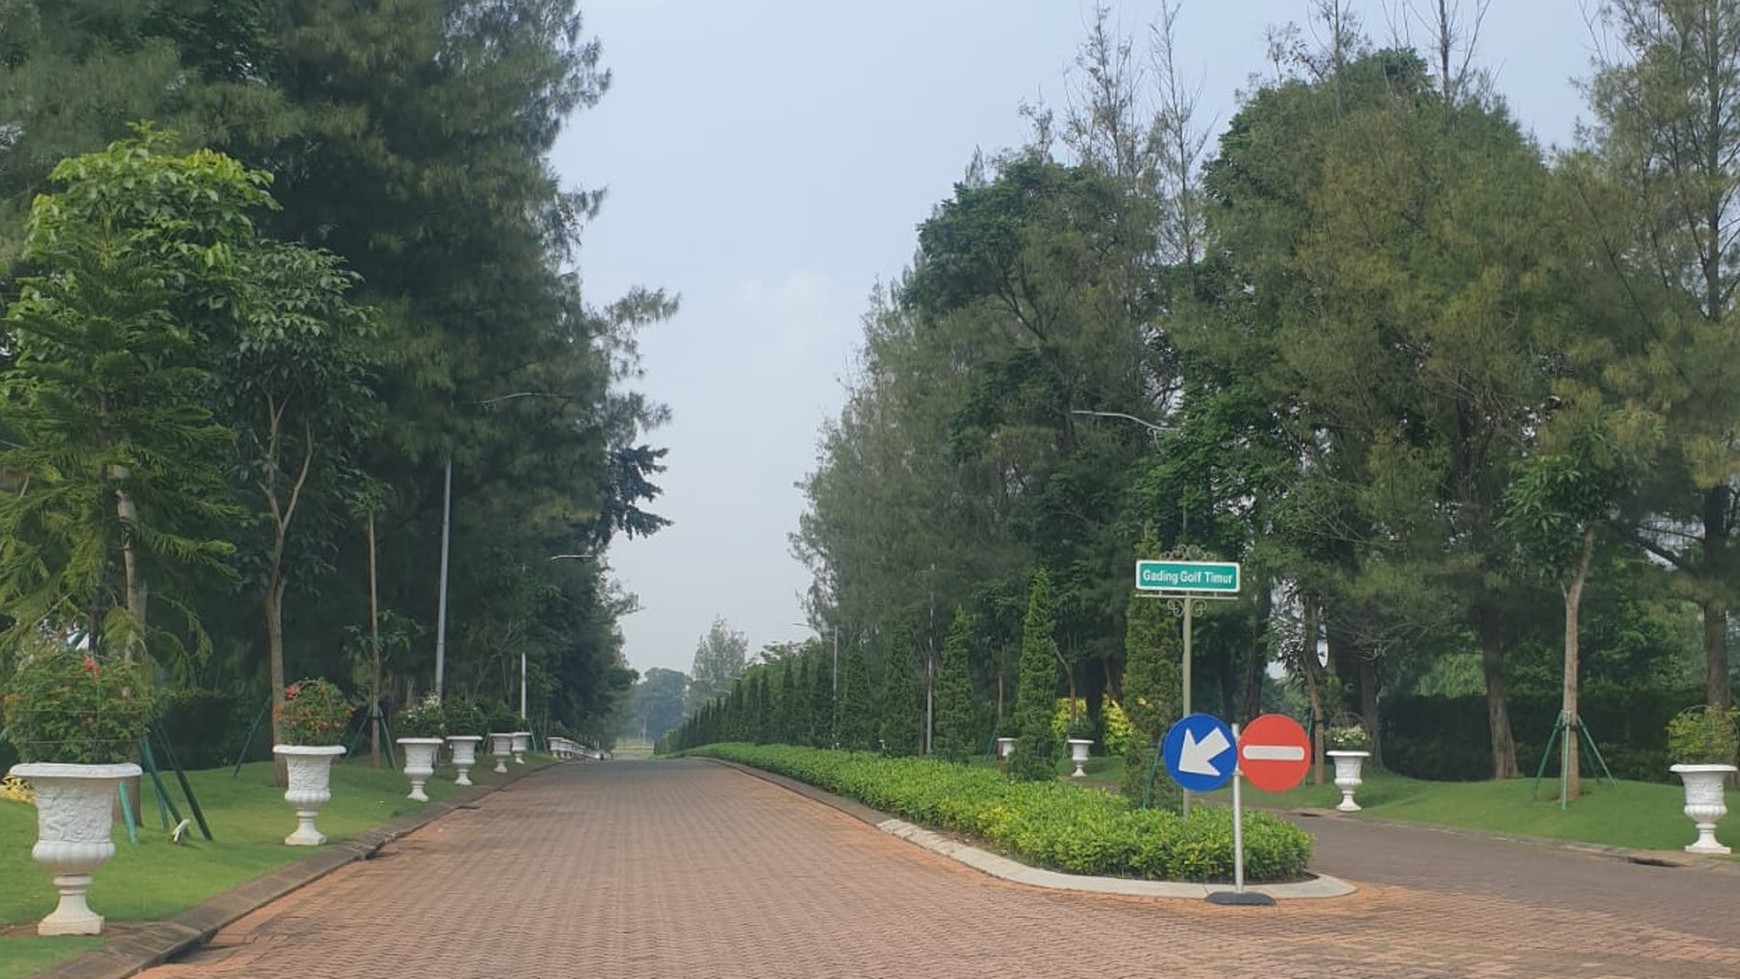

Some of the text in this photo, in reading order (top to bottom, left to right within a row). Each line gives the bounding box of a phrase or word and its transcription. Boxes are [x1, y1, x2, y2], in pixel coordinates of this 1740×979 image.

[1142, 569, 1233, 584] Gading Golf Timur
